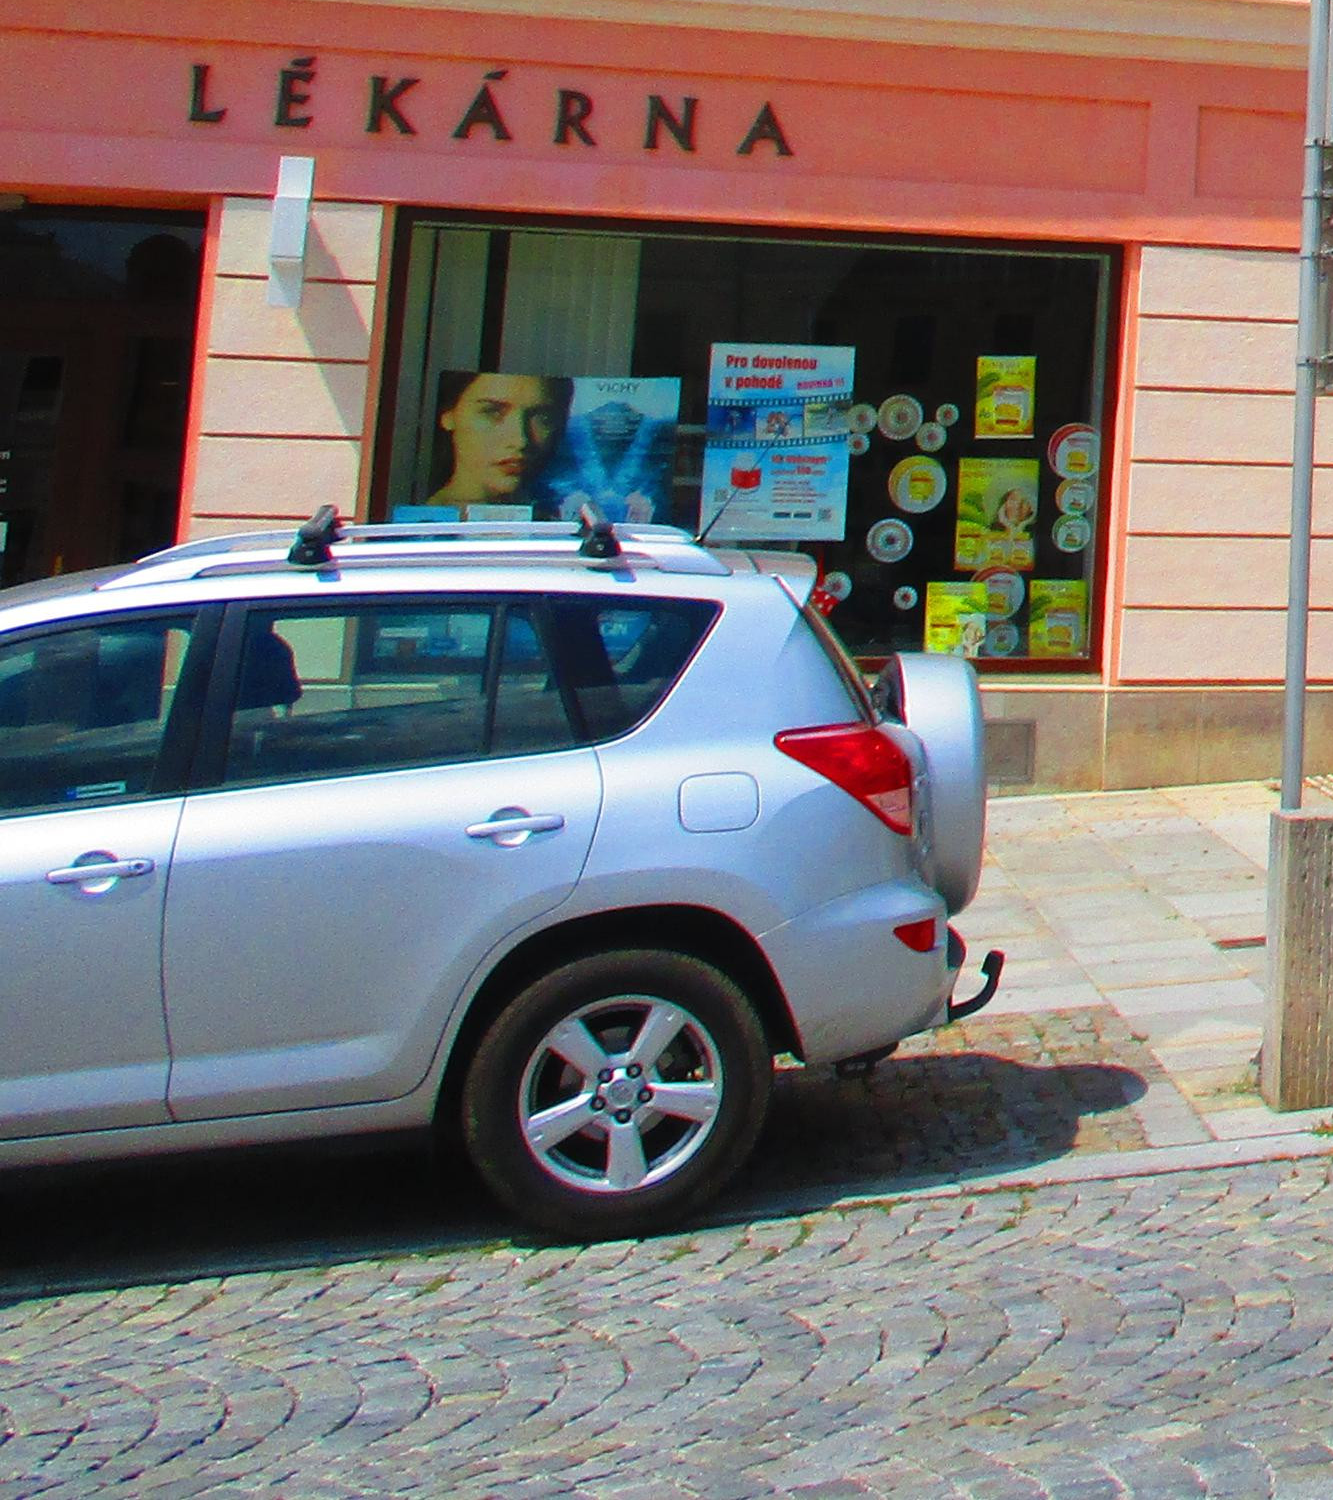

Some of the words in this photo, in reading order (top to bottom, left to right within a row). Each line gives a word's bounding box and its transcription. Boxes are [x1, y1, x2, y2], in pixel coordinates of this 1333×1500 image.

[188, 56, 794, 156] LÉKÁRNA
[725, 355, 748, 368] Pro
[751, 355, 818, 370] dovolenou
